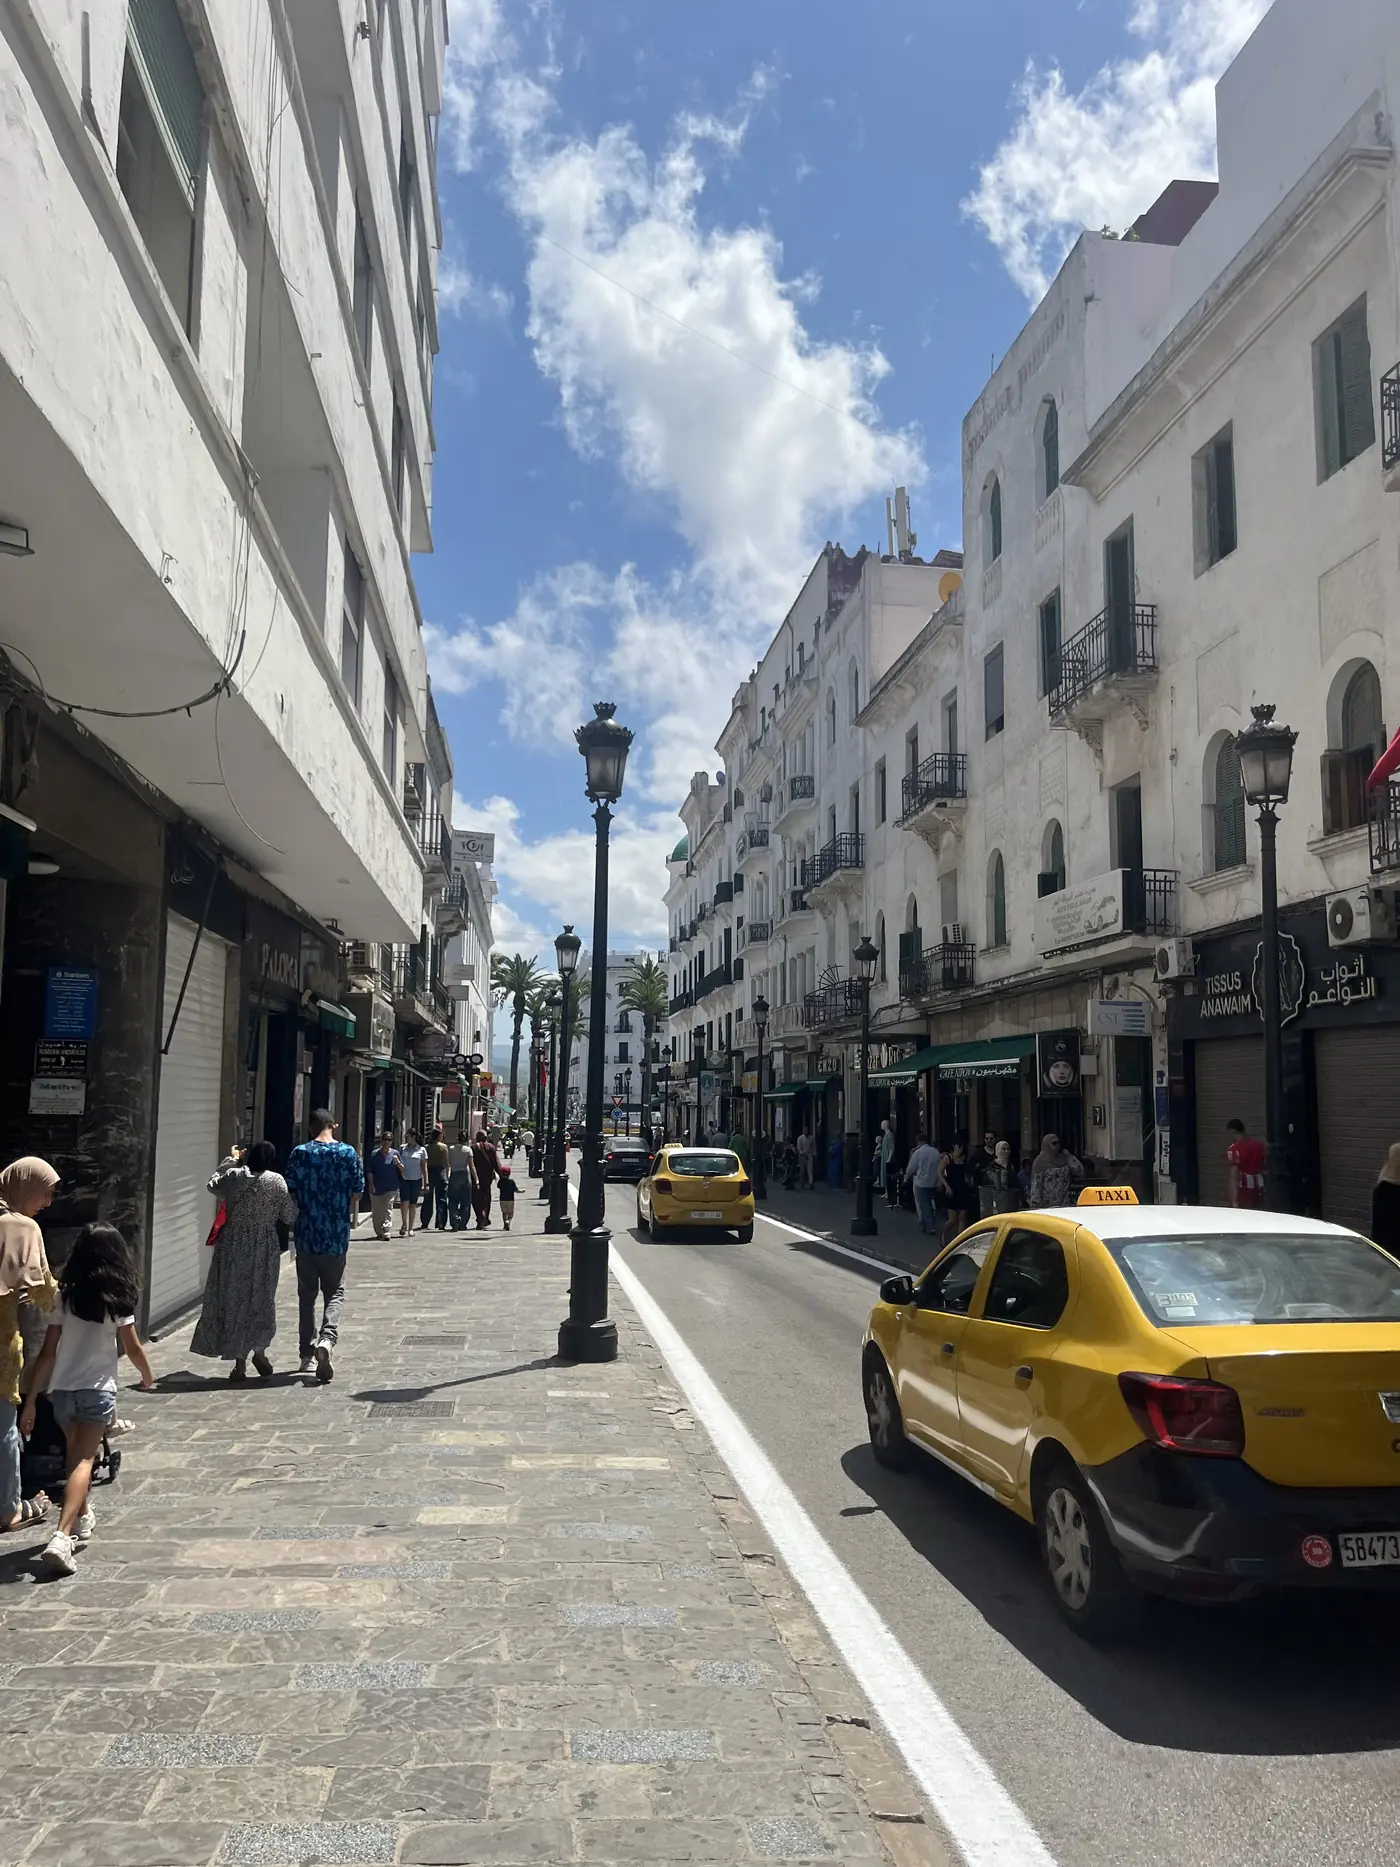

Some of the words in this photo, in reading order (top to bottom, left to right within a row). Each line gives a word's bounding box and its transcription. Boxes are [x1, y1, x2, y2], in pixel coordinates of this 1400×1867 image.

[1321, 954, 1364, 984] أثواب
[1205, 972, 1241, 995] TISSUS
[1306, 977, 1376, 1007] النواعم
[1200, 994, 1251, 1018] ANAWAIM
[1095, 1189, 1131, 1202] TAXI
[1343, 1535, 1400, 1562] 58473
